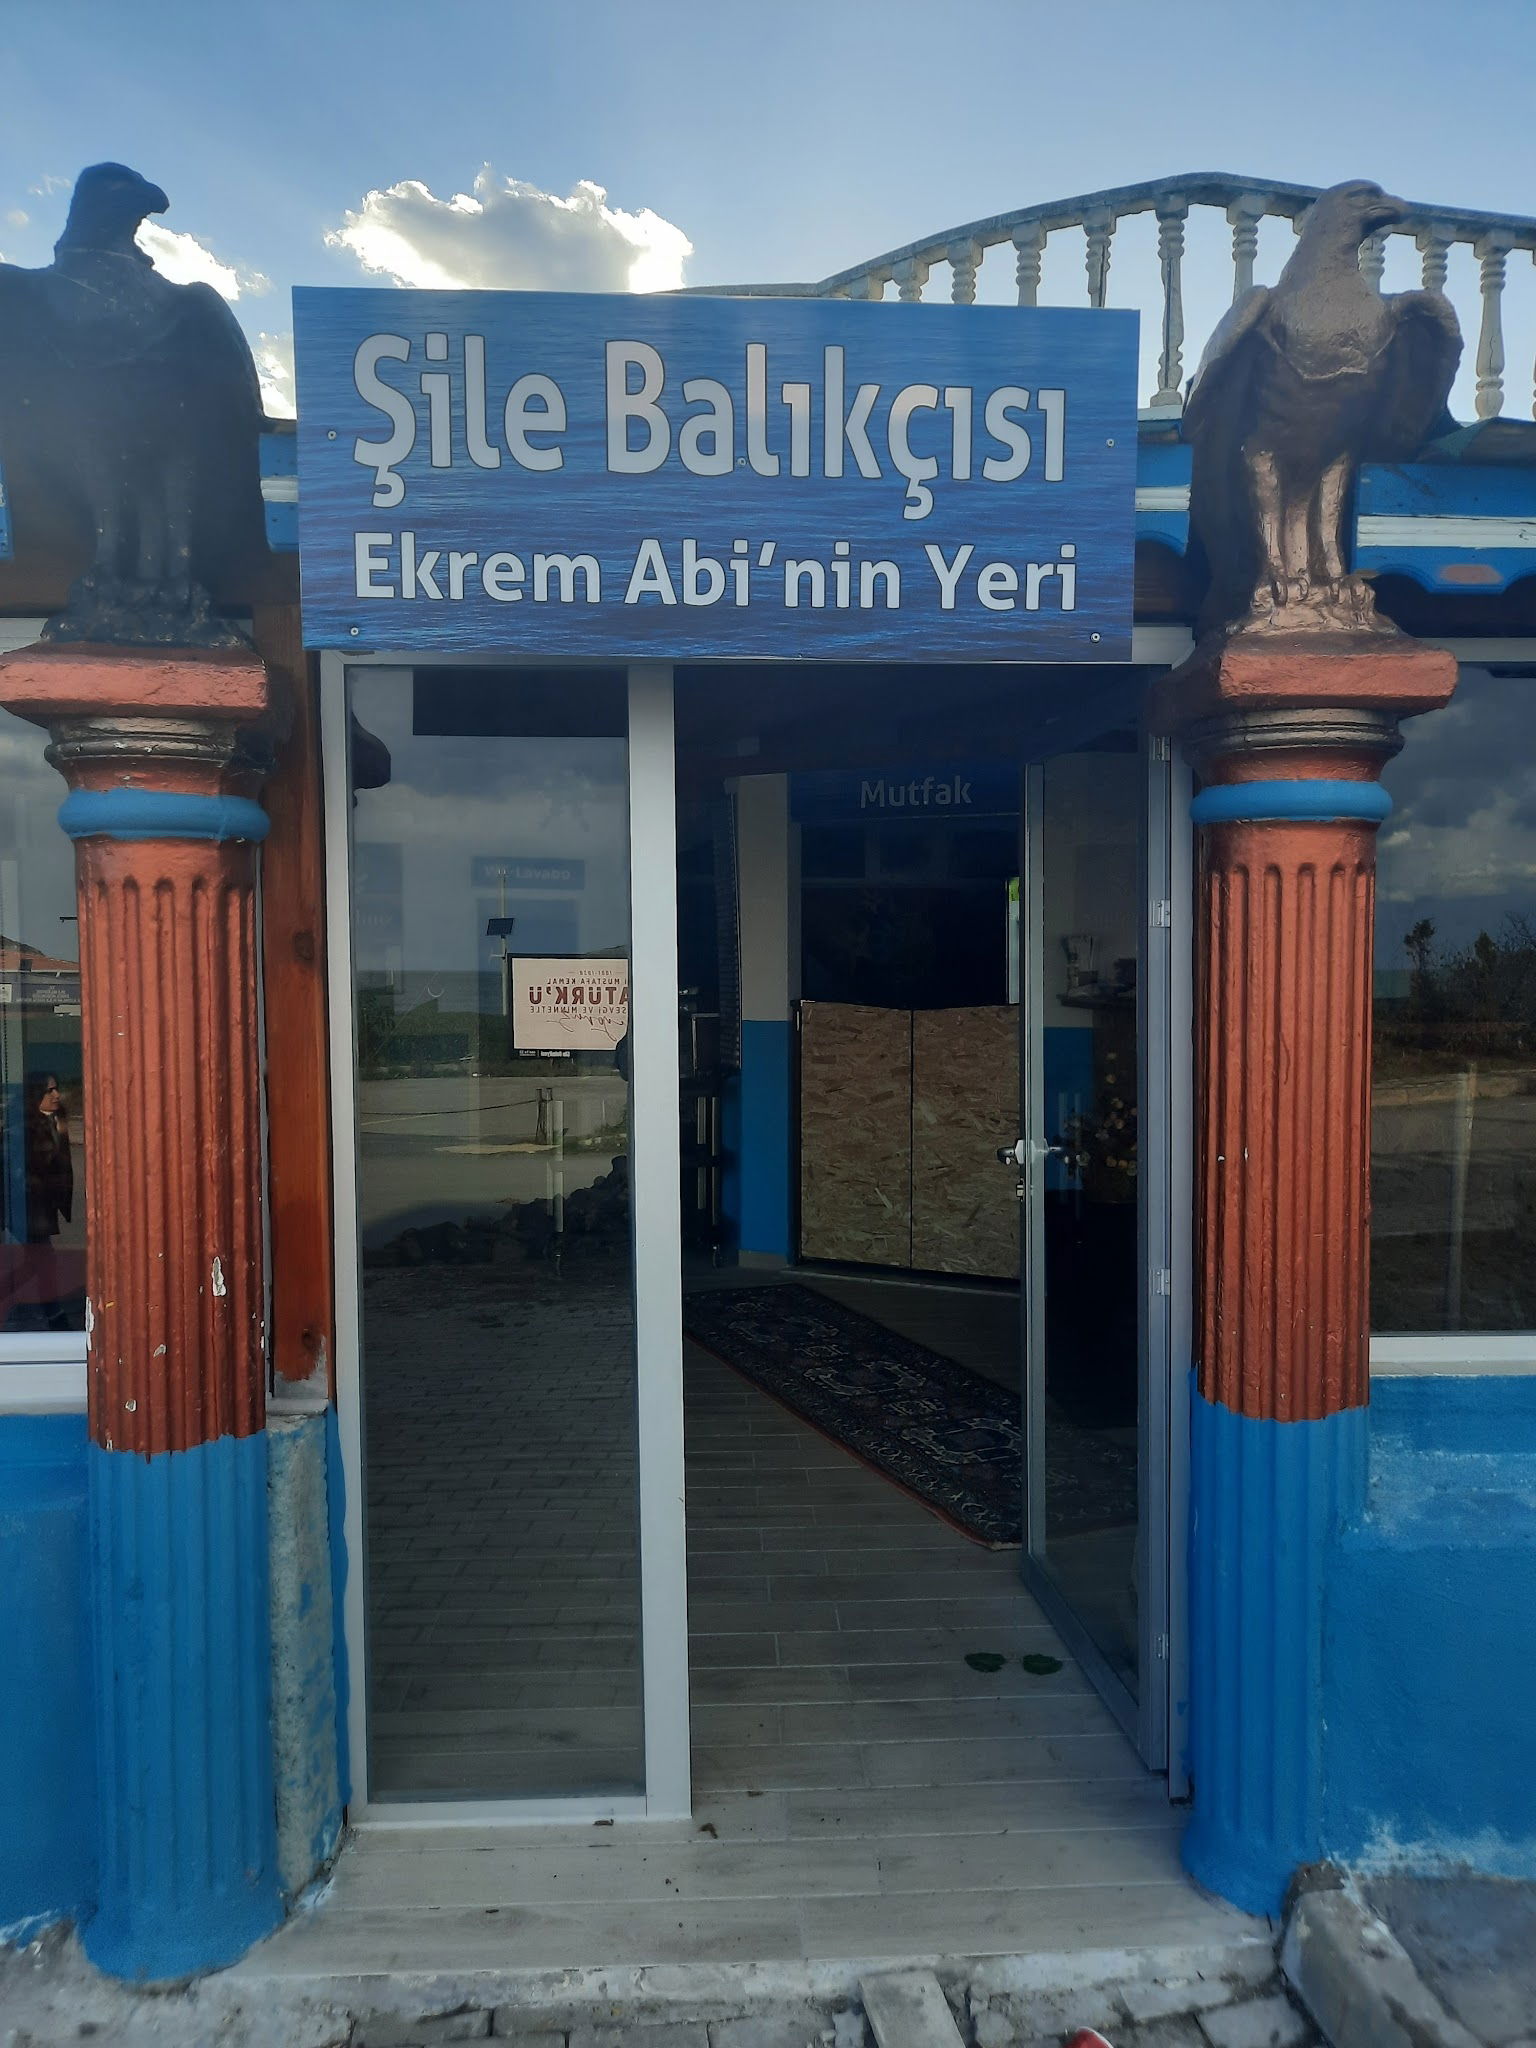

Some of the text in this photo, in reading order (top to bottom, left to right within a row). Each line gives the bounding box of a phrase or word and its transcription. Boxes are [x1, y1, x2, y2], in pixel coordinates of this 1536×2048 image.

[353, 332, 1066, 521] Şile Balıkçısı
[354, 531, 1076, 611] Ekrem Abi'nin Yeri
[860, 775, 973, 808] Mutfak
